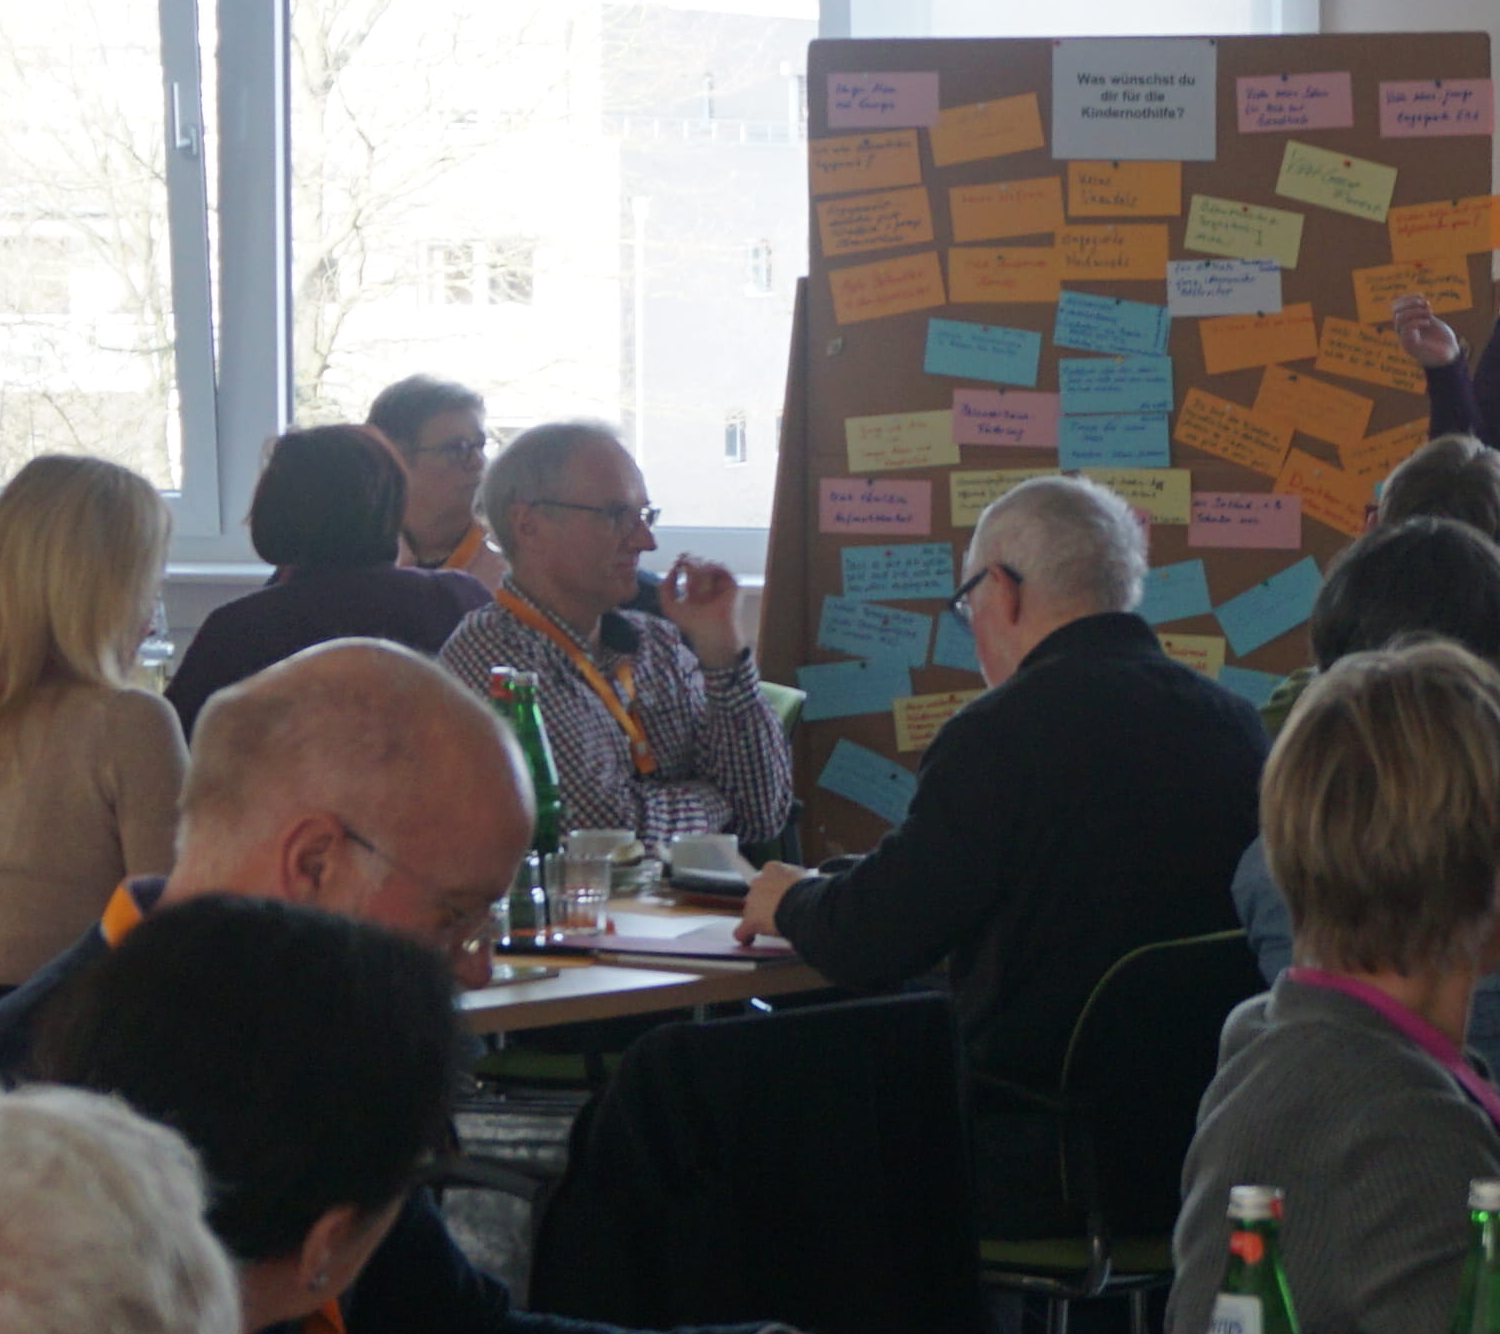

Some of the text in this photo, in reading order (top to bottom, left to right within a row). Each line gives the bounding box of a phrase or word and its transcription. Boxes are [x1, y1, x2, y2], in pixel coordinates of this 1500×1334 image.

[1077, 72, 1196, 86] Was wünschst du
[1100, 89, 1165, 102] dir für die
[1081, 106, 1185, 119] Kindernothilfe?
